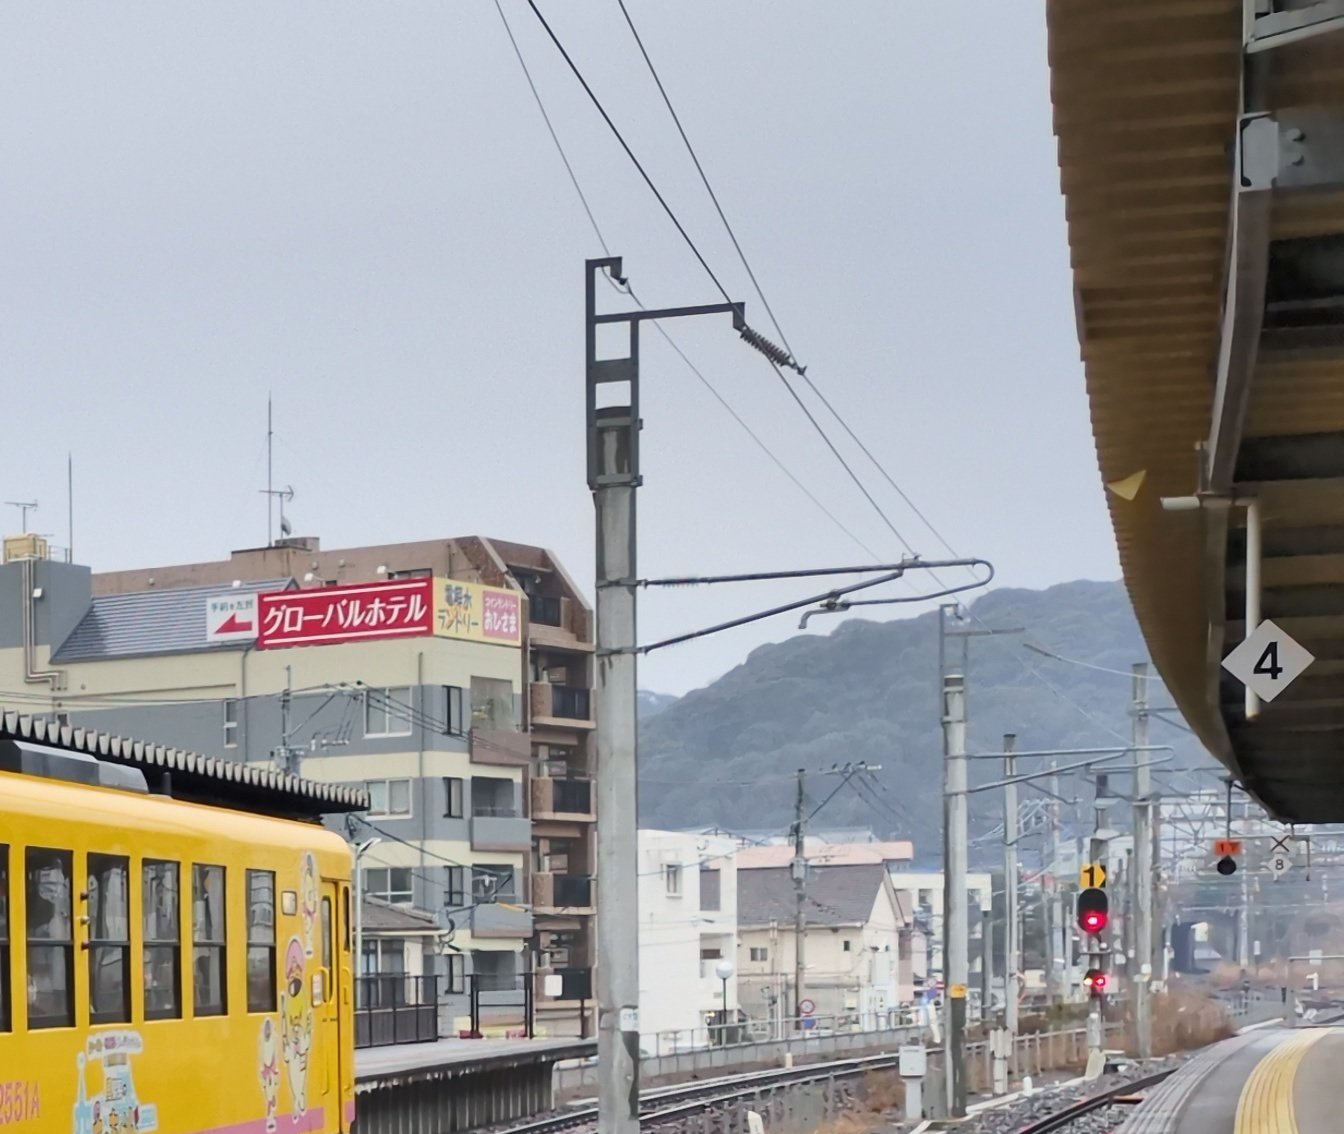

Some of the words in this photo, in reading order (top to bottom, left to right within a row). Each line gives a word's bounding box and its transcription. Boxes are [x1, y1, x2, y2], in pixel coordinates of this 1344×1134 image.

[263, 594, 427, 636] グローバルホテル
[1253, 641, 1283, 680] 4
[1084, 867, 1095, 887] 1
[1275, 858, 1284, 871] 8
